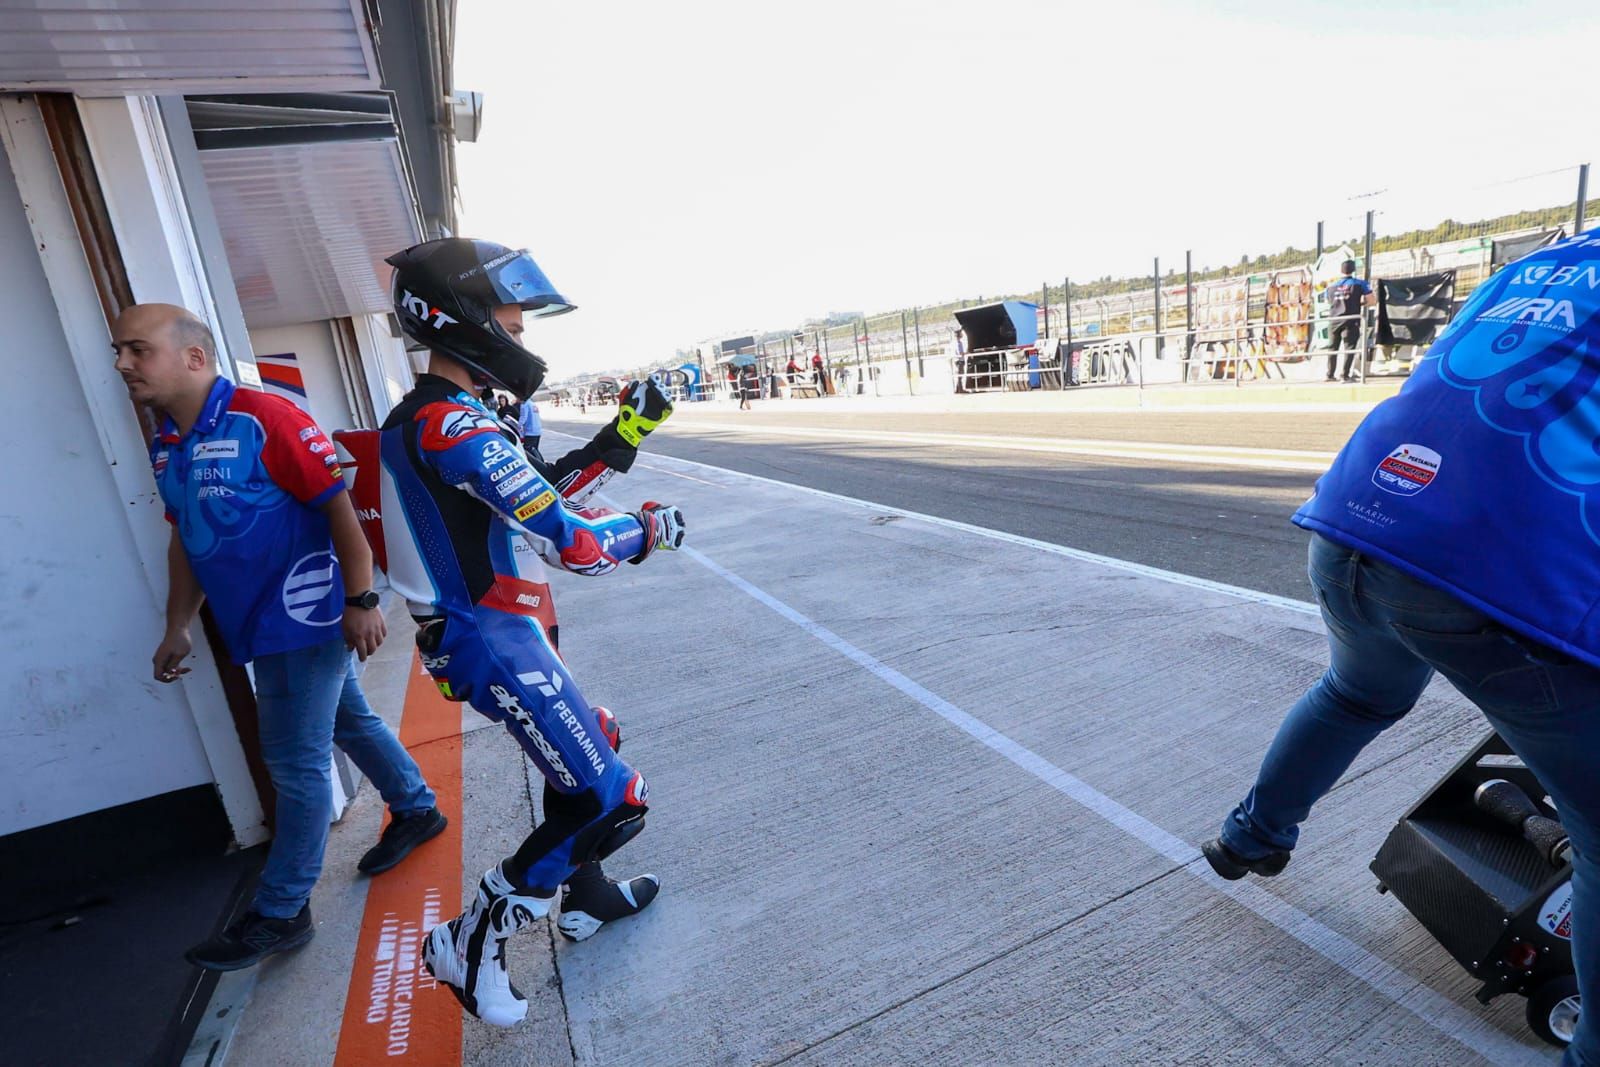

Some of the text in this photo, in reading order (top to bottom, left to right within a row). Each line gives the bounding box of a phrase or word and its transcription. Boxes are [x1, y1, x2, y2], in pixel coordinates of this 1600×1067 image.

[401, 288, 460, 330] KYT
[203, 467, 232, 480] BNI
[518, 491, 553, 519] PIRELLI
[489, 684, 578, 788] alpinestars
[552, 699, 606, 777] PERTAMINA
[366, 960, 396, 1024] TORMO
[386, 973, 416, 1057] RICARDO
